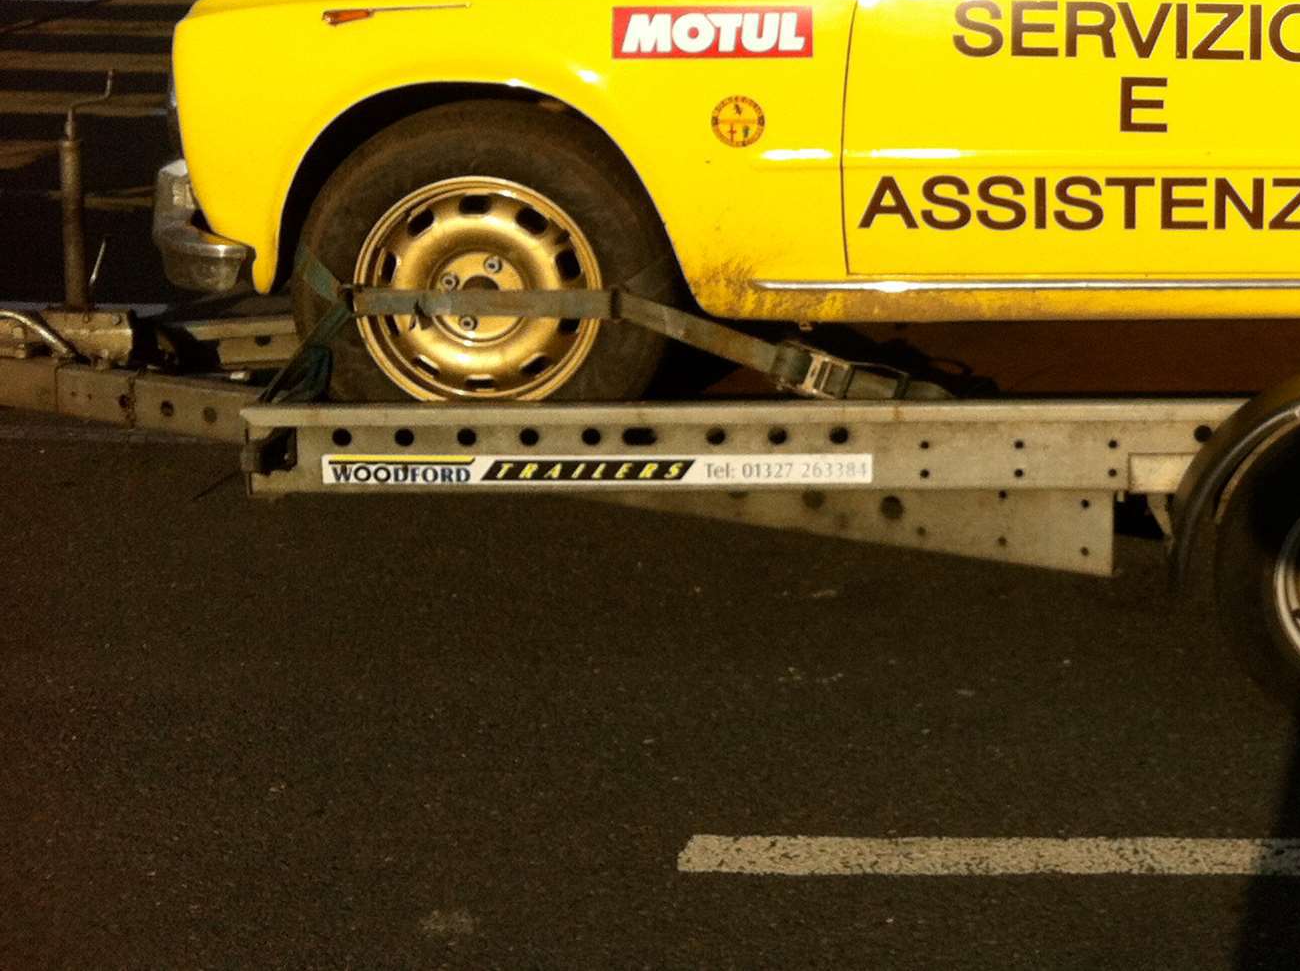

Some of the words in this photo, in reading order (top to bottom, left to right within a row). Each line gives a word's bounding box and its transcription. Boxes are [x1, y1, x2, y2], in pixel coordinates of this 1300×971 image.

[621, 12, 805, 53] MOTUL
[1119, 76, 1169, 133] E
[331, 465, 471, 483] WOODFORD
[496, 463, 683, 479] TRAILERS
[706, 462, 736, 478] Tel:
[741, 462, 793, 478] 01327
